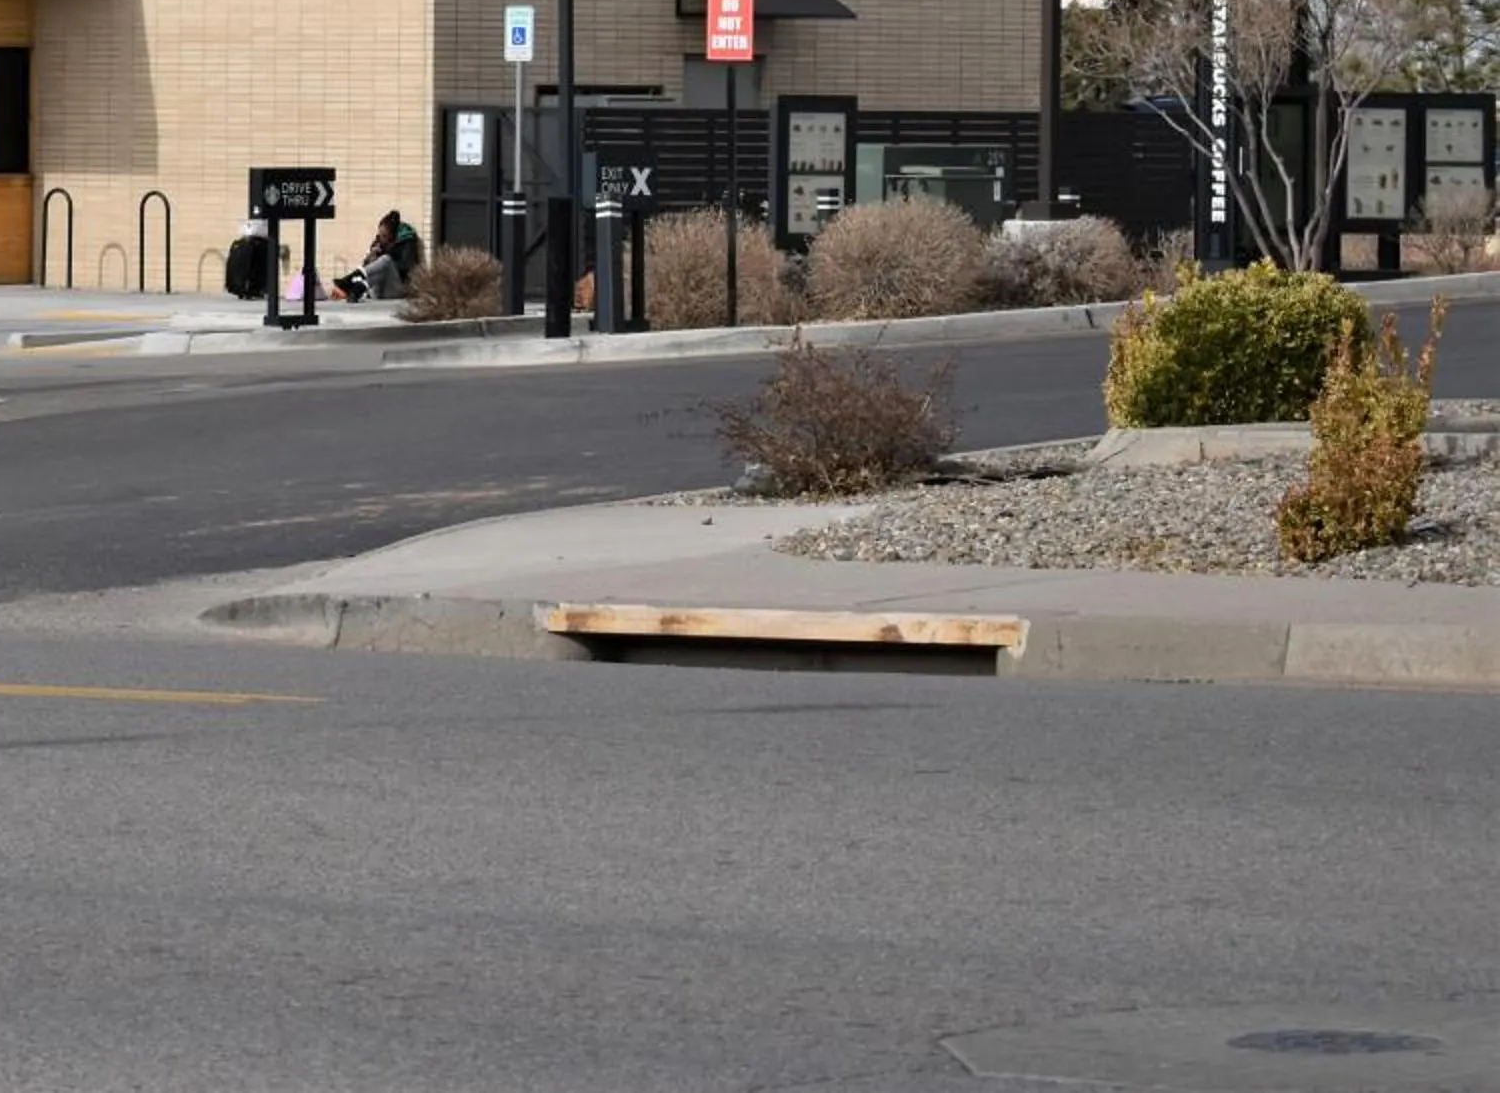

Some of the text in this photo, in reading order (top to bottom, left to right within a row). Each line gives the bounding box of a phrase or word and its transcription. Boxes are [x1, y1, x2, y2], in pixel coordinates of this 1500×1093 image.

[717, 16, 743, 31] NOT
[711, 34, 748, 51] ENTER
[601, 166, 624, 180] EXIT
[281, 181, 313, 194] DRIVE
[1211, 138, 1226, 223] COFFEE
[601, 181, 629, 195] ONLY
[282, 195, 309, 206] THRU
